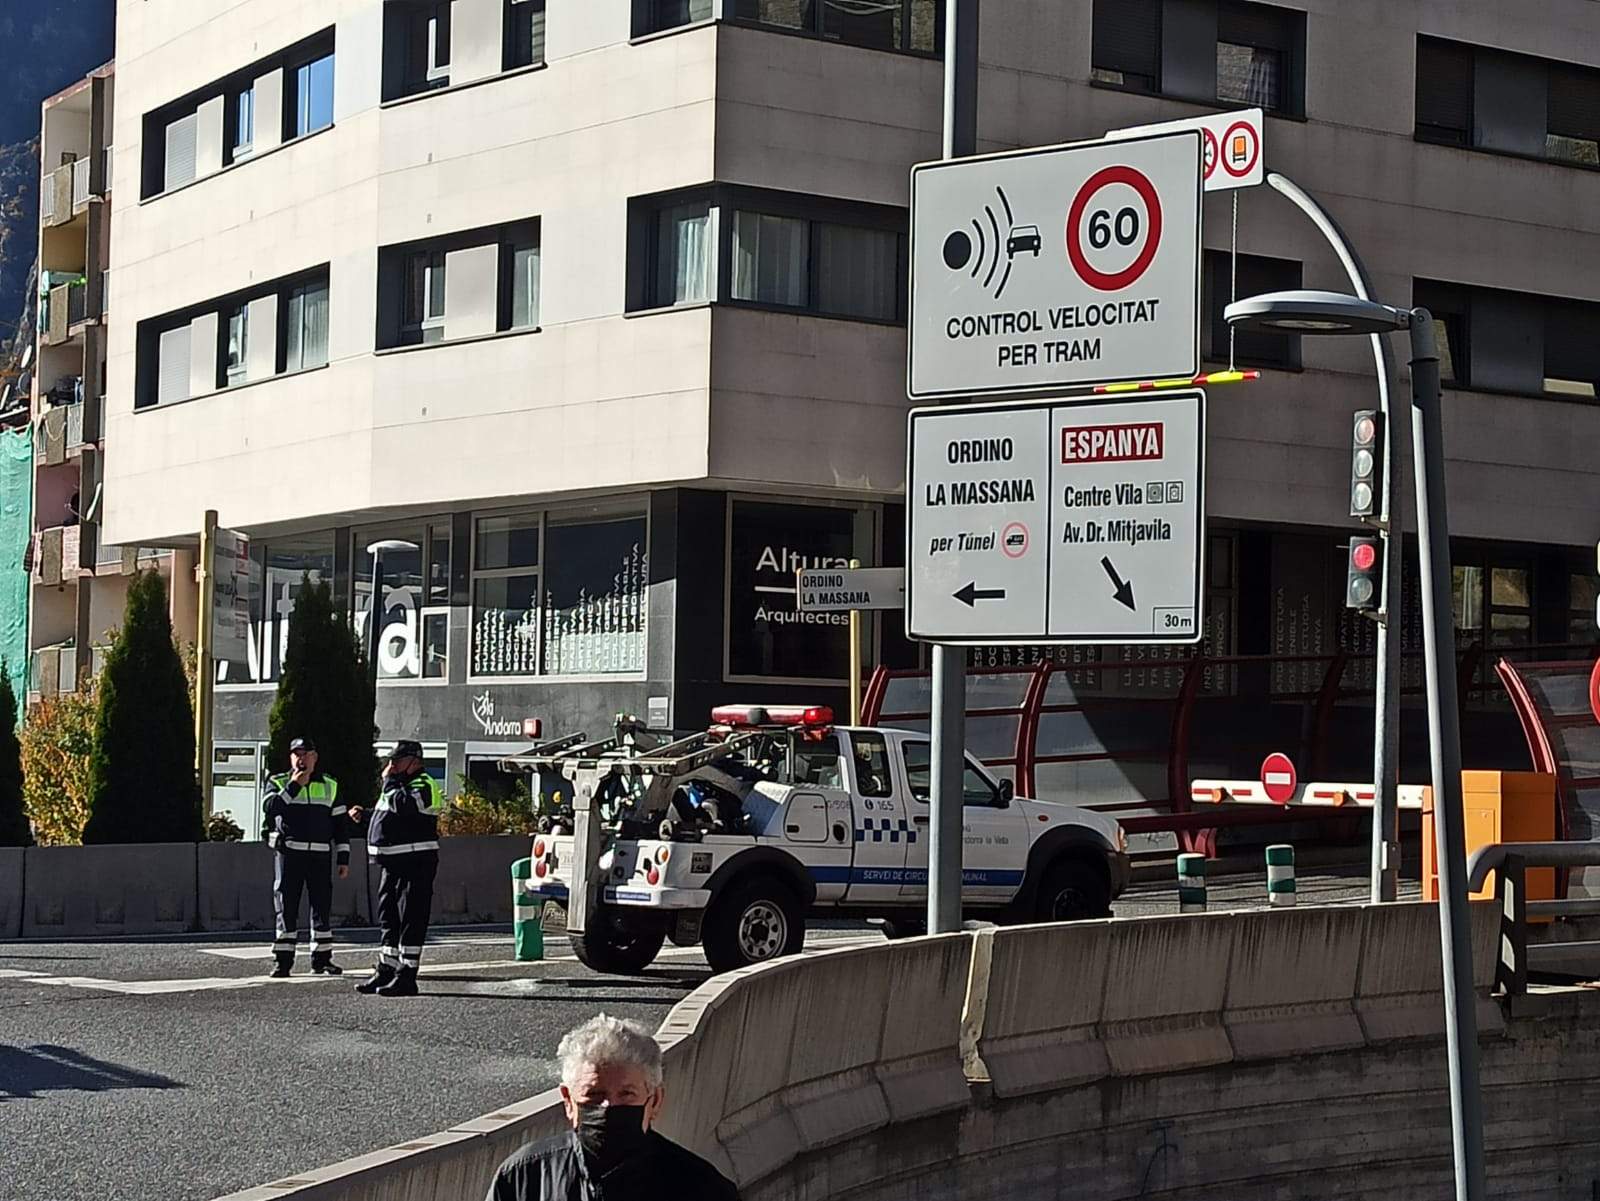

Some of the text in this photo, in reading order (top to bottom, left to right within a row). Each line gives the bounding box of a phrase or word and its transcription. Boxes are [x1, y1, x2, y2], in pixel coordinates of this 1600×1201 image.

[1088, 206, 1140, 250] 60
[946, 299, 1159, 339] CONTROL VELOCITAT
[997, 338, 1101, 367] PER TRAM
[947, 438, 1013, 464] ORDINO
[1065, 427, 1159, 459] ESPANYA
[926, 479, 1035, 506] LA MASSANA
[1064, 483, 1143, 507] Centre Vila
[930, 532, 996, 556] per Túnel
[1107, 518, 1171, 546] Mitjavila
[802, 575, 843, 587] ORDINO
[802, 591, 871, 605] LA MASSANA
[754, 607, 849, 625] Arquitectes
[482, 609, 490, 672] HUMANA
[484, 716, 521, 736] Andorra
[877, 800, 894, 811] 165
[863, 870, 928, 881] SERVEI DE CIRCU
